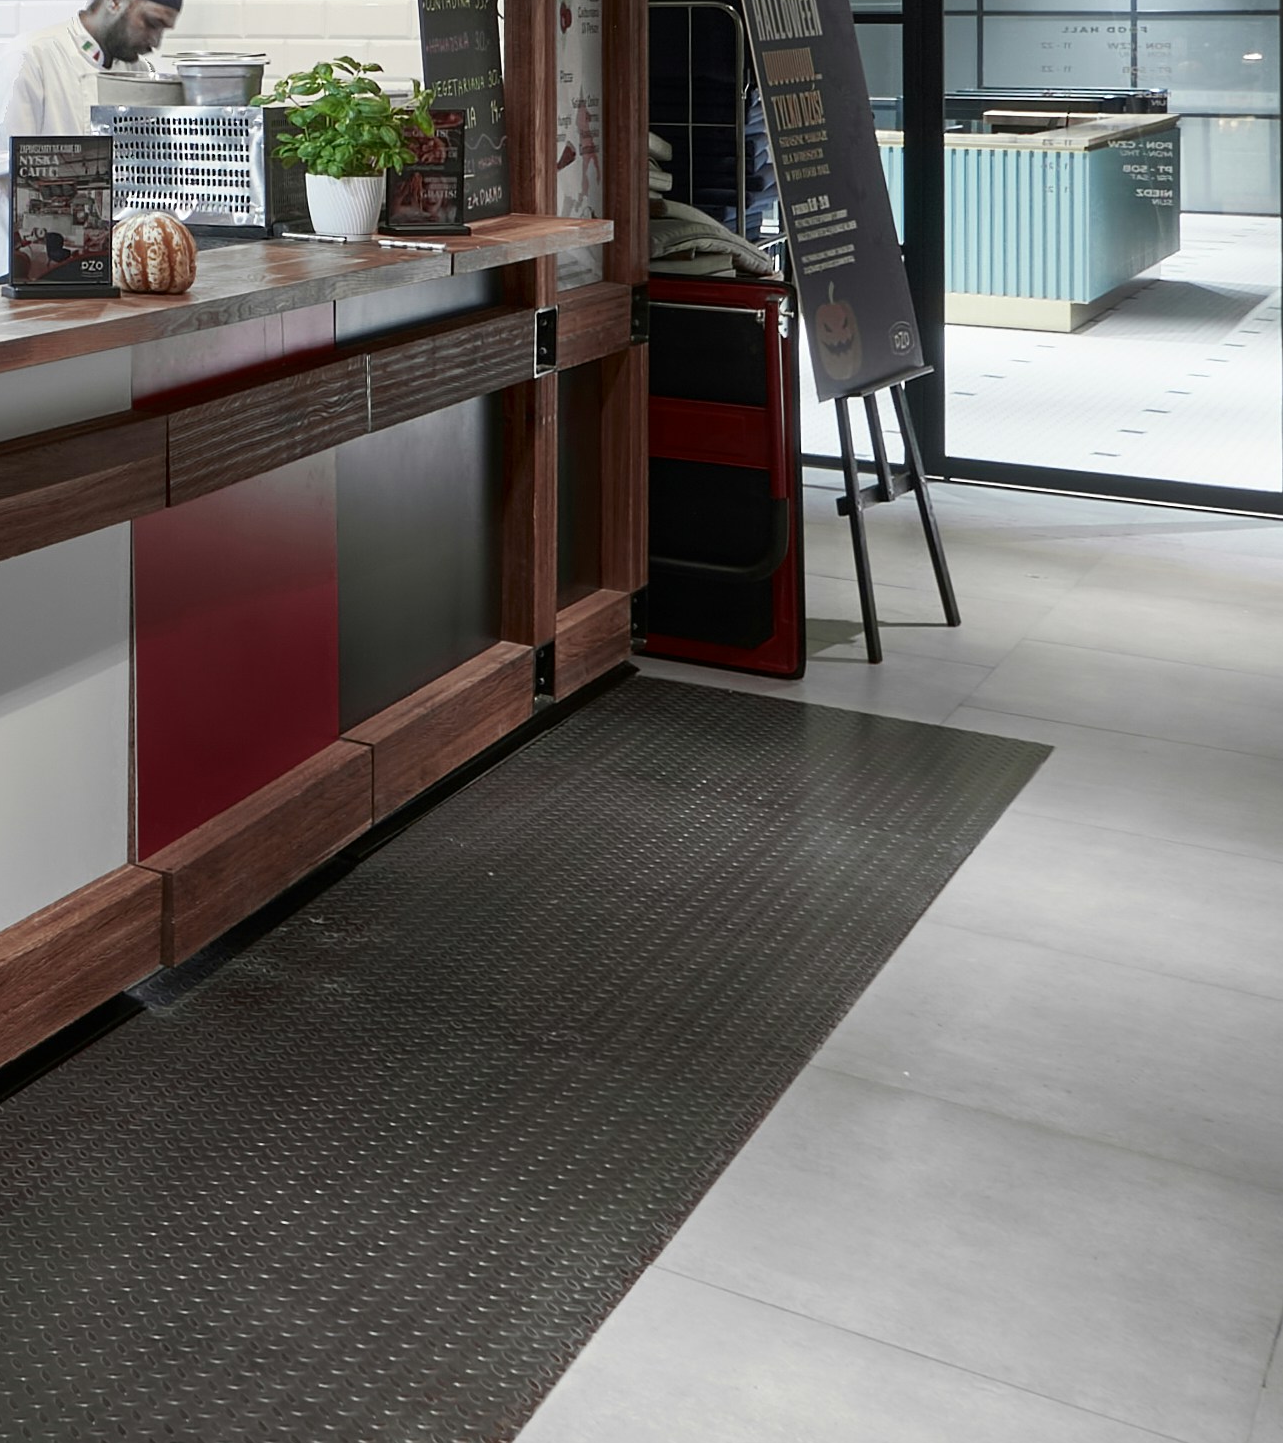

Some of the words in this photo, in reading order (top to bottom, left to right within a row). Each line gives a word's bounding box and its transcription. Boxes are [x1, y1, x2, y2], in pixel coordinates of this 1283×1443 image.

[433, 76, 485, 98] VEGETARIANA
[771, 93, 803, 131] TYLKO
[19, 155, 60, 166] NYSKA
